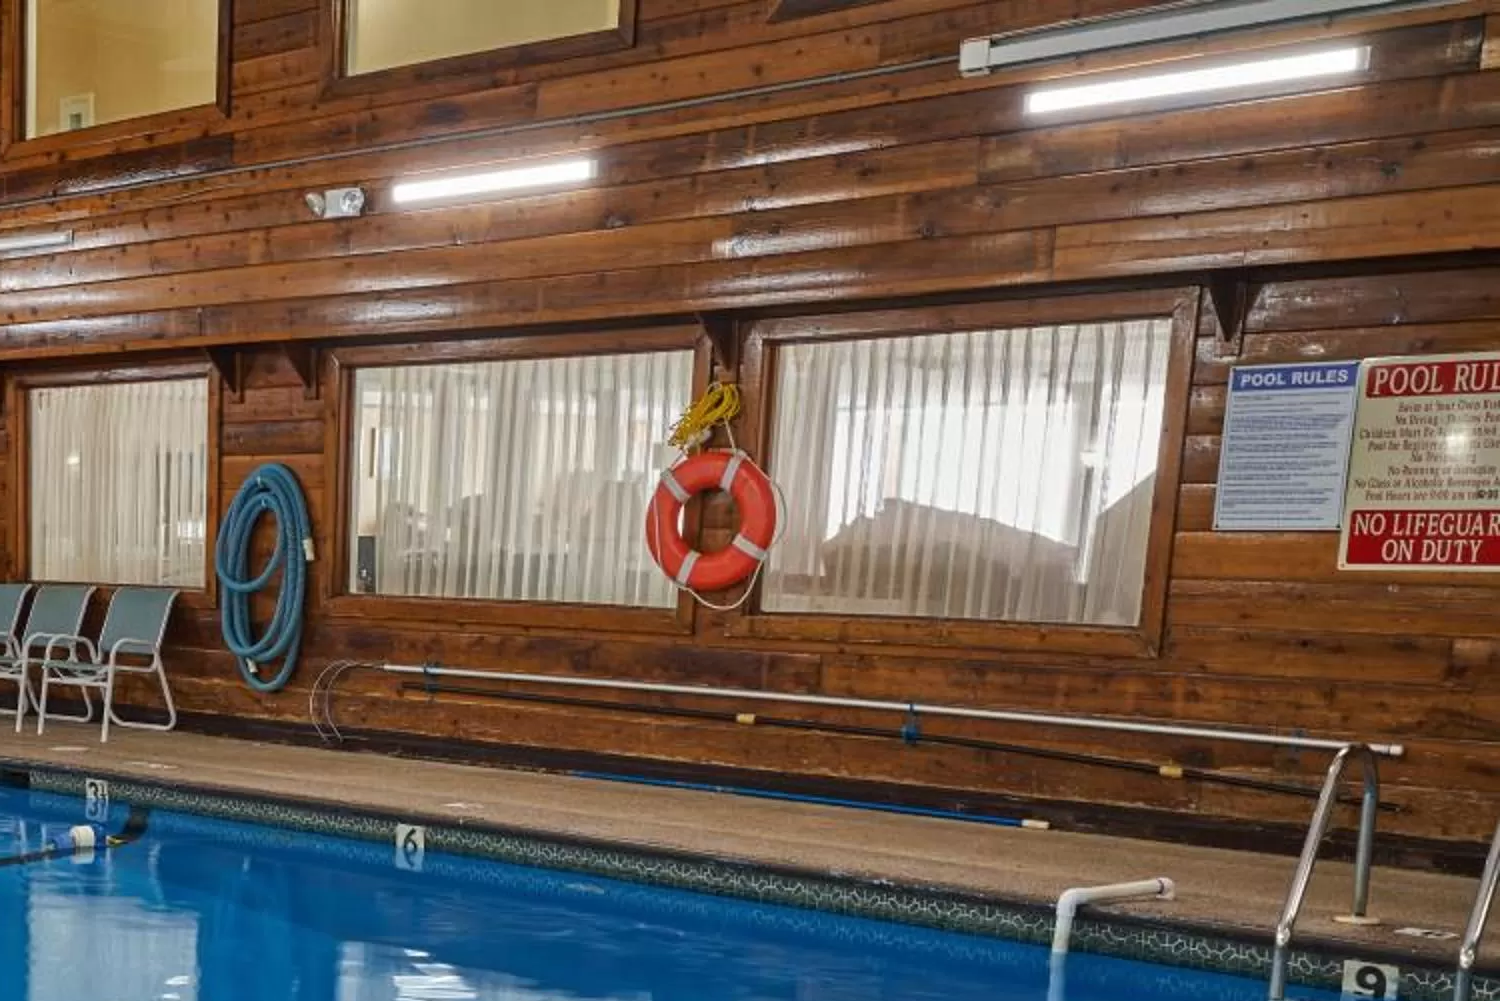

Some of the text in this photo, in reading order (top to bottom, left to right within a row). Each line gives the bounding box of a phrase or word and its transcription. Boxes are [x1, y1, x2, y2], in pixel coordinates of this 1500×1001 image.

[1241, 369, 1349, 388] POOL RULES
[1372, 365, 1444, 395] POOL
[1353, 512, 1500, 537] NO LIFEGUAR
[1381, 539, 1483, 563] ON DUTY
[1354, 965, 1387, 999] 9
